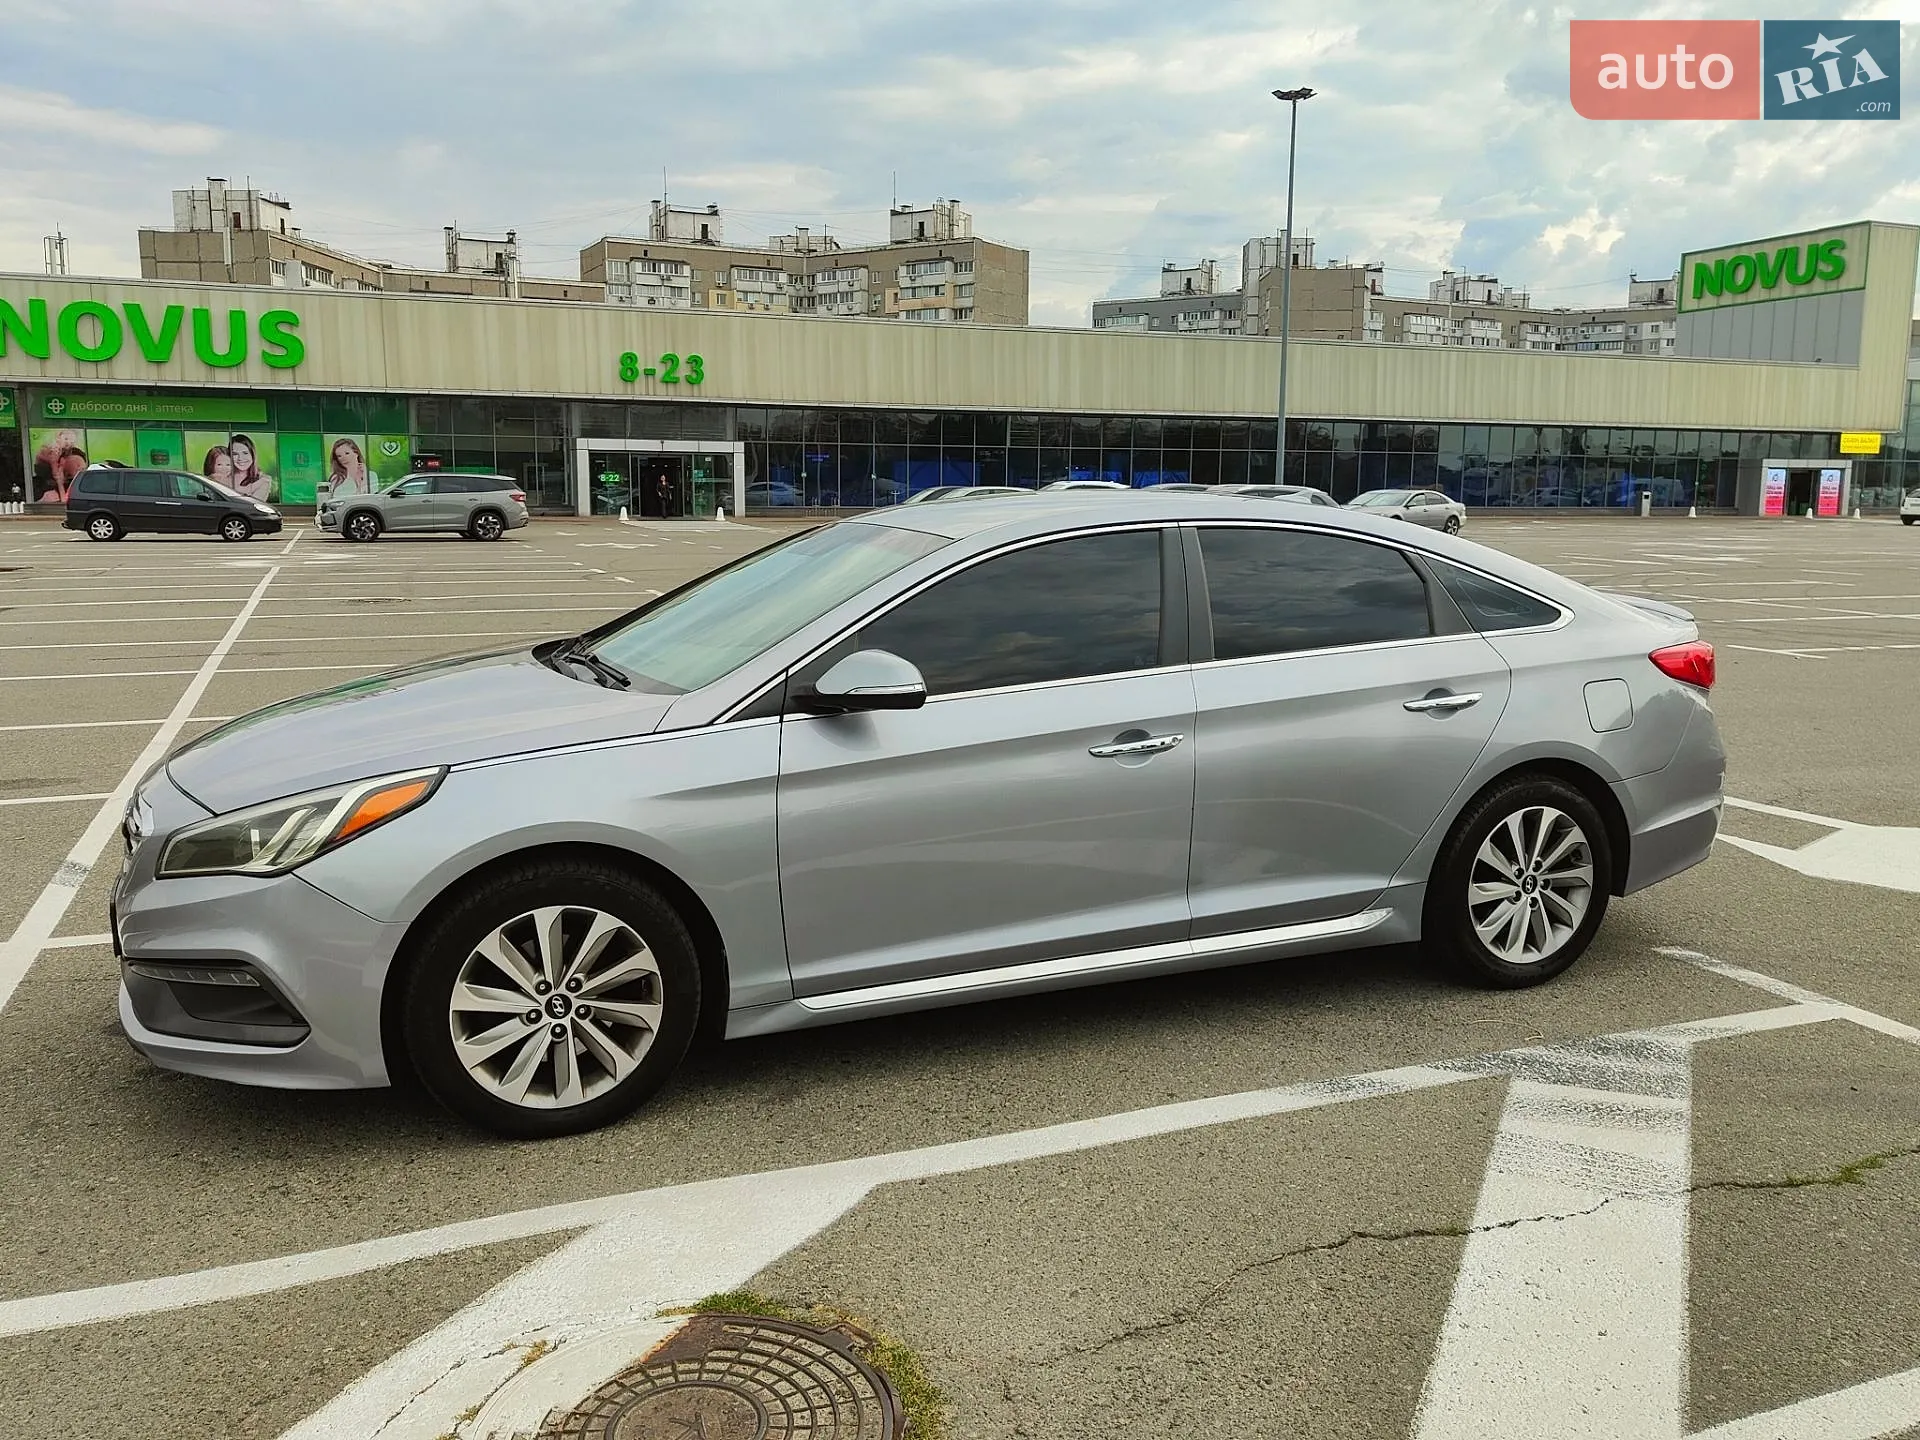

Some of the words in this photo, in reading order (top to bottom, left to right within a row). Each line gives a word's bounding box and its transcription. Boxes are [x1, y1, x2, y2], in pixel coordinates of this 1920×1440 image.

[1692, 239, 1847, 299] NOVUS
[0, 297, 305, 369] NOVUS
[619, 351, 706, 385] 8-23
[70, 401, 122, 415] доброго
[125, 403, 148, 414] дня
[155, 404, 194, 414] аптека
[600, 474, 620, 482] 8-22
